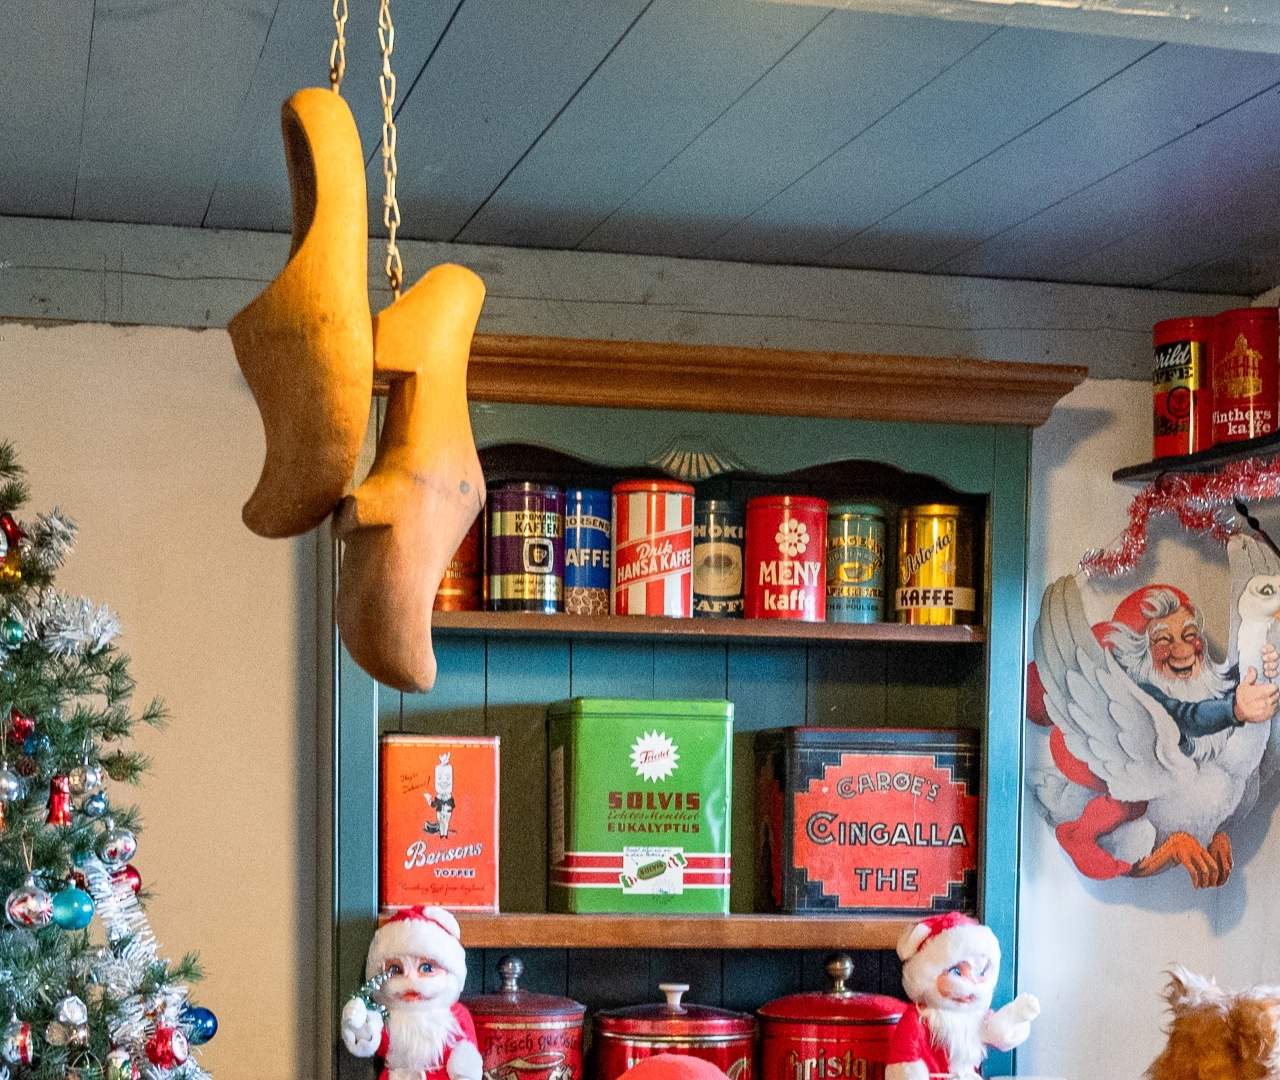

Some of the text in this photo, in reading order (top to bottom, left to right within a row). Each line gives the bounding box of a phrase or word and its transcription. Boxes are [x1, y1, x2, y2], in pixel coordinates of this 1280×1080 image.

[515, 522, 559, 534] KAFFEN
[694, 525, 743, 540] HOKI
[566, 548, 610, 568] AFFE
[635, 540, 674, 560] Drik
[901, 530, 954, 584] Astoria
[617, 547, 692, 584] HANSA KAFFE
[758, 561, 821, 587] MENY
[763, 588, 816, 611] kaffe
[900, 589, 954, 606] KAFFE
[608, 791, 701, 811] SOLVIS
[607, 822, 700, 834] EUKALYPTUS
[805, 811, 969, 847] CINGALLA
[404, 840, 484, 870] Bensons
[434, 868, 476, 878] TOFFEE
[854, 867, 919, 892] THE
